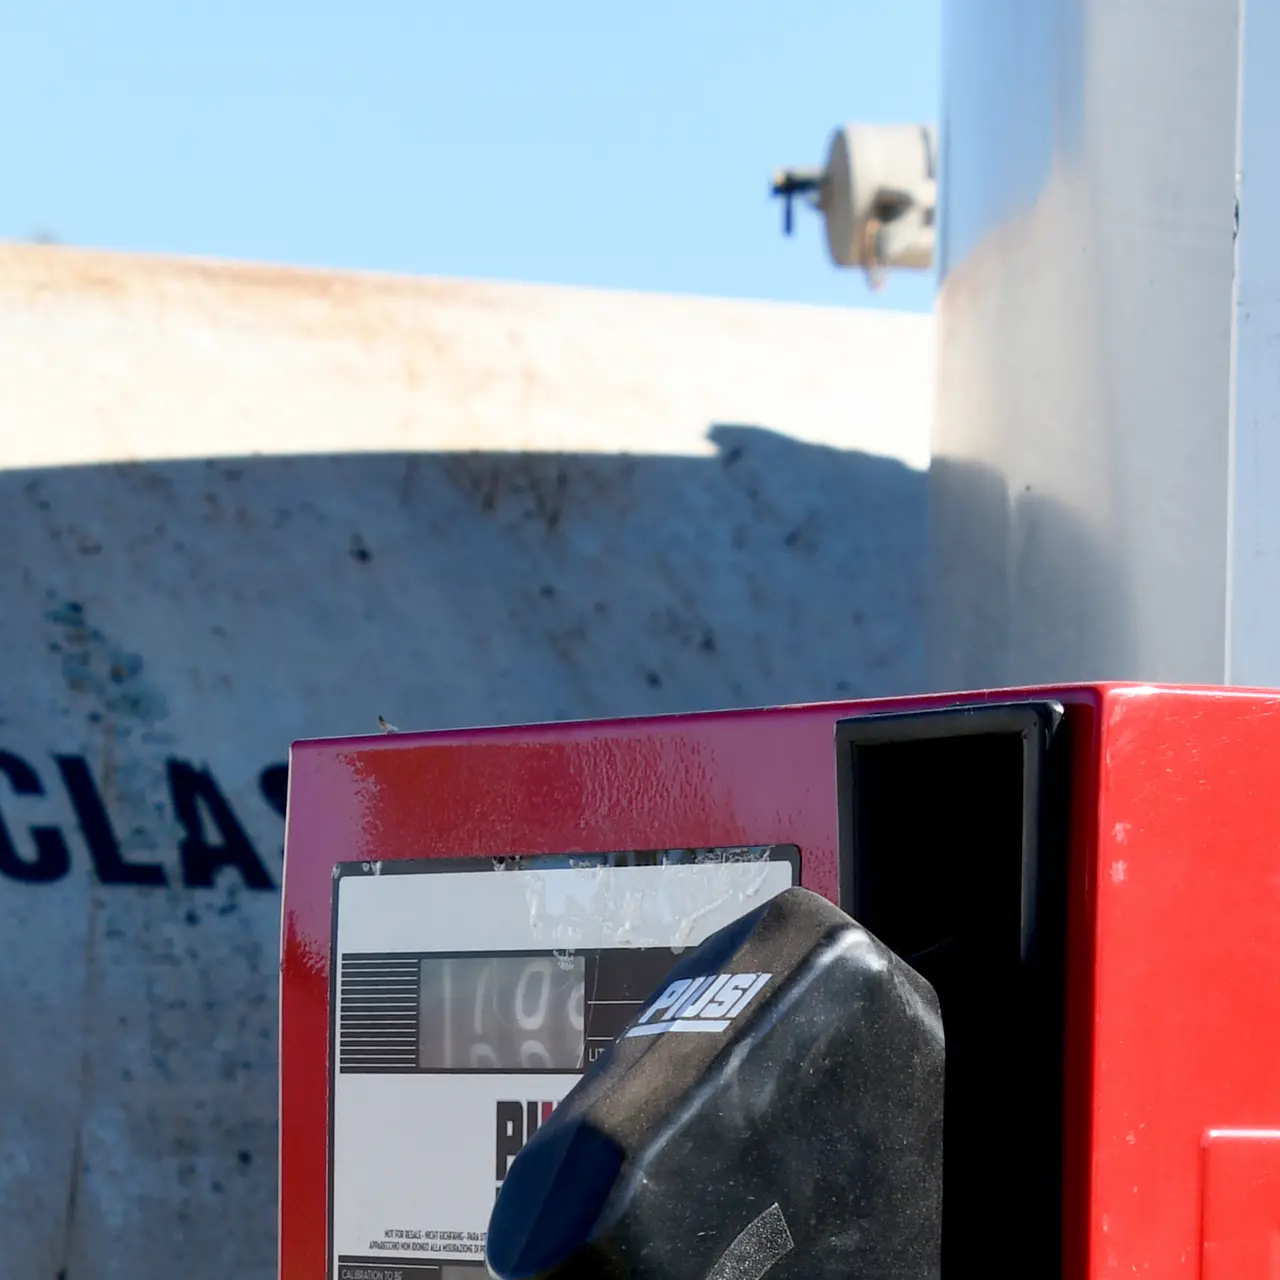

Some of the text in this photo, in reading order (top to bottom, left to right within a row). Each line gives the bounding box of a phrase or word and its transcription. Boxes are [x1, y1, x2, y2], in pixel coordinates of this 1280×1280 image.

[637, 972, 773, 1024] PIUSI
[341, 1268, 384, 1280] CALIBRATION
[384, 1270, 393, 1280] TO
